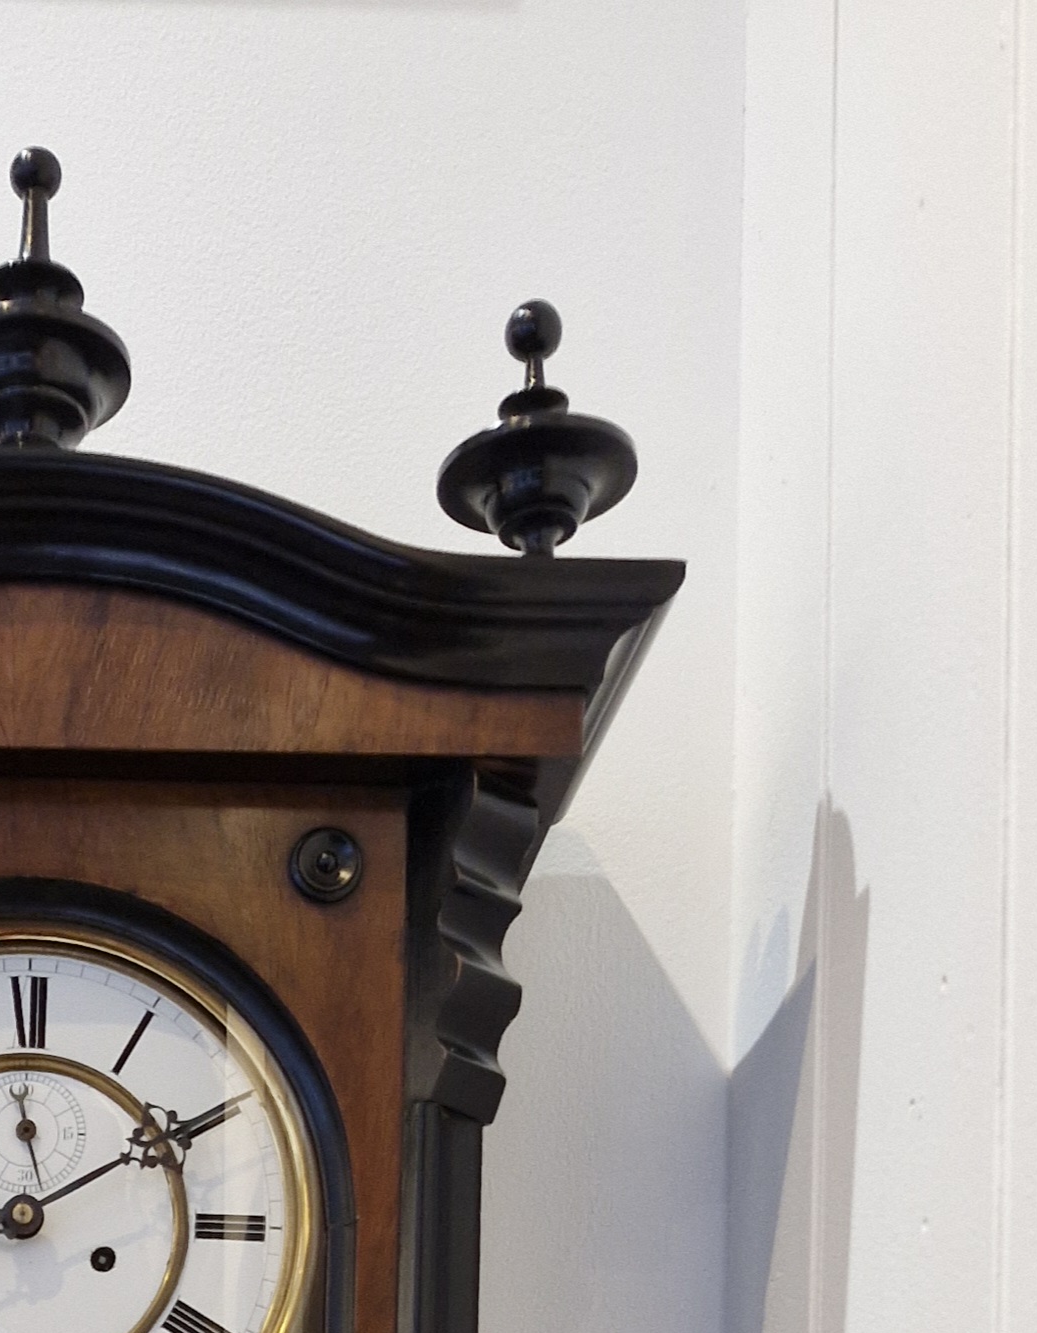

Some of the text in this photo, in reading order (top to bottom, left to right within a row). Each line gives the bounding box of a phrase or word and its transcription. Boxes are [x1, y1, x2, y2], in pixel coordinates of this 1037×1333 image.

[8, 976, 49, 1049] XII
[110, 1008, 159, 1076] I
[193, 1210, 267, 1243] III
